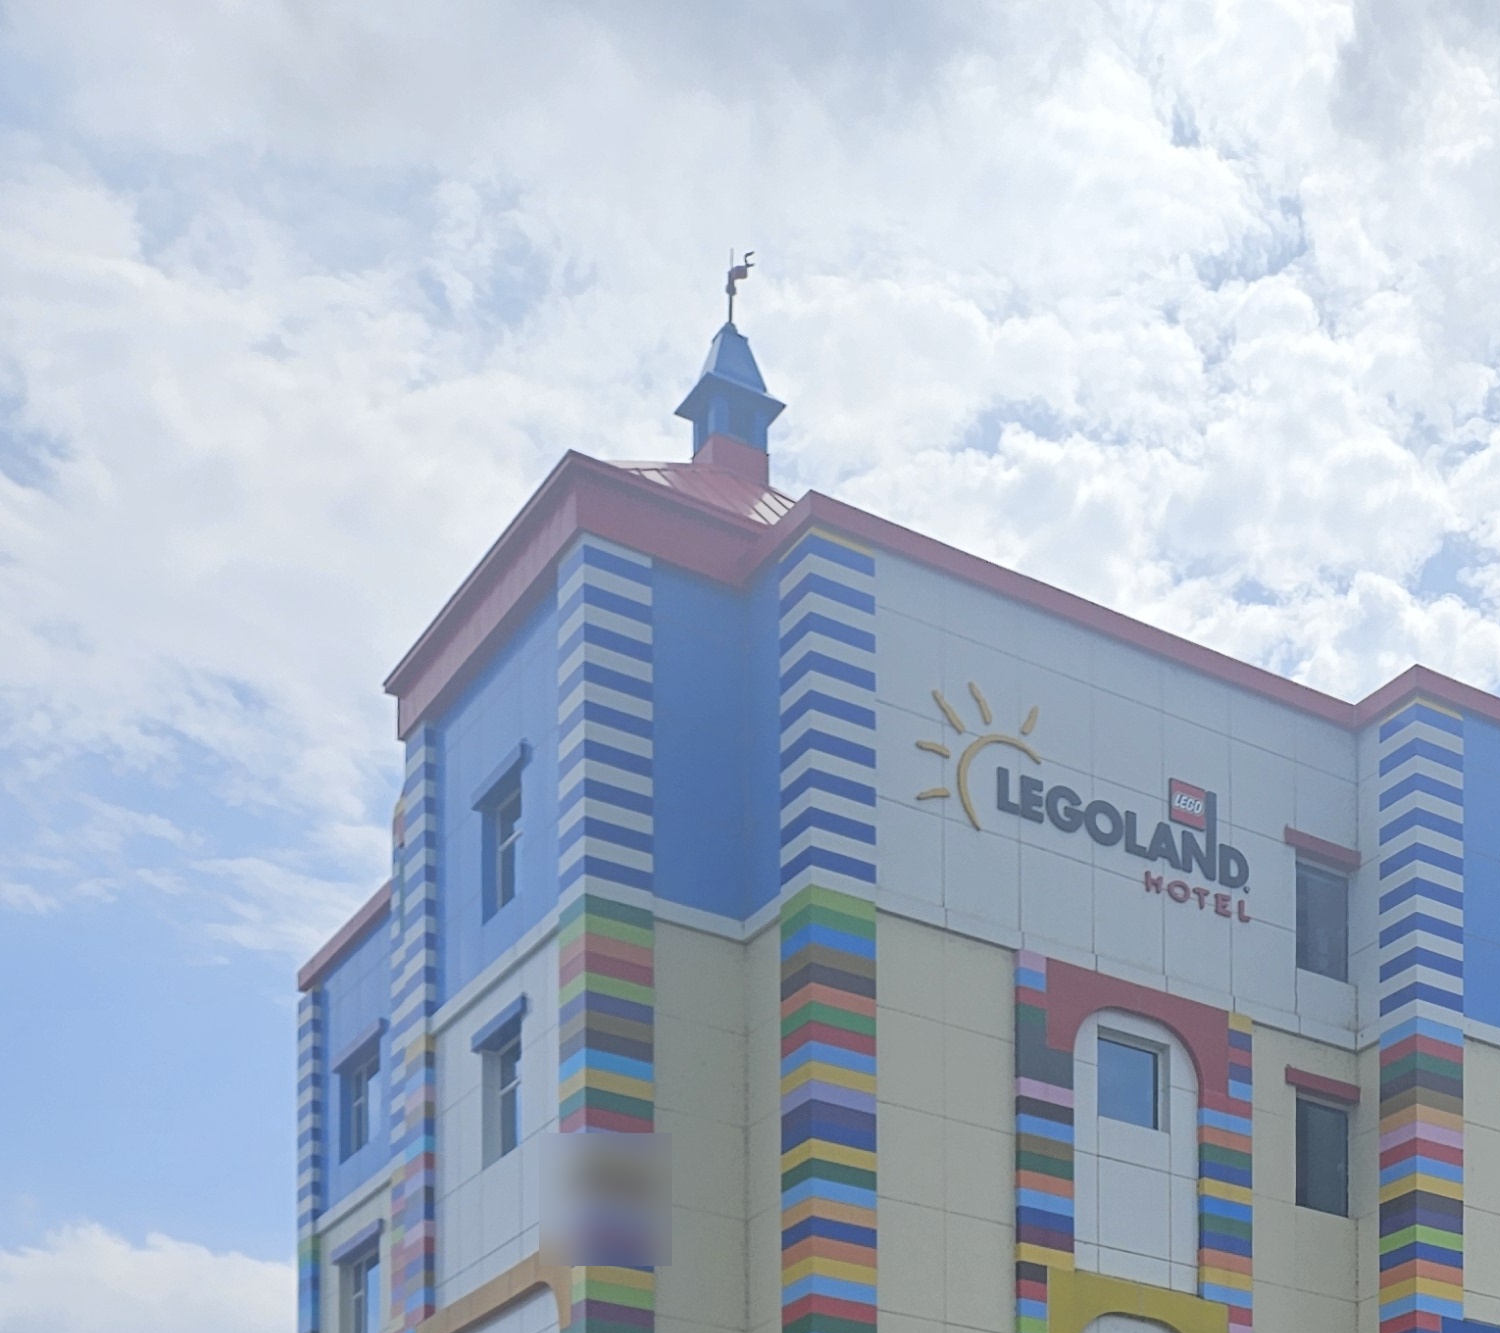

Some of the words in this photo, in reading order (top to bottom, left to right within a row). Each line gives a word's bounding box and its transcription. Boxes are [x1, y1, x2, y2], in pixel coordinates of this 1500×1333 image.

[996, 766, 1249, 889] LEGOLAND
[1174, 794, 1203, 814] LEGO
[1144, 870, 1251, 923] HOTEL
